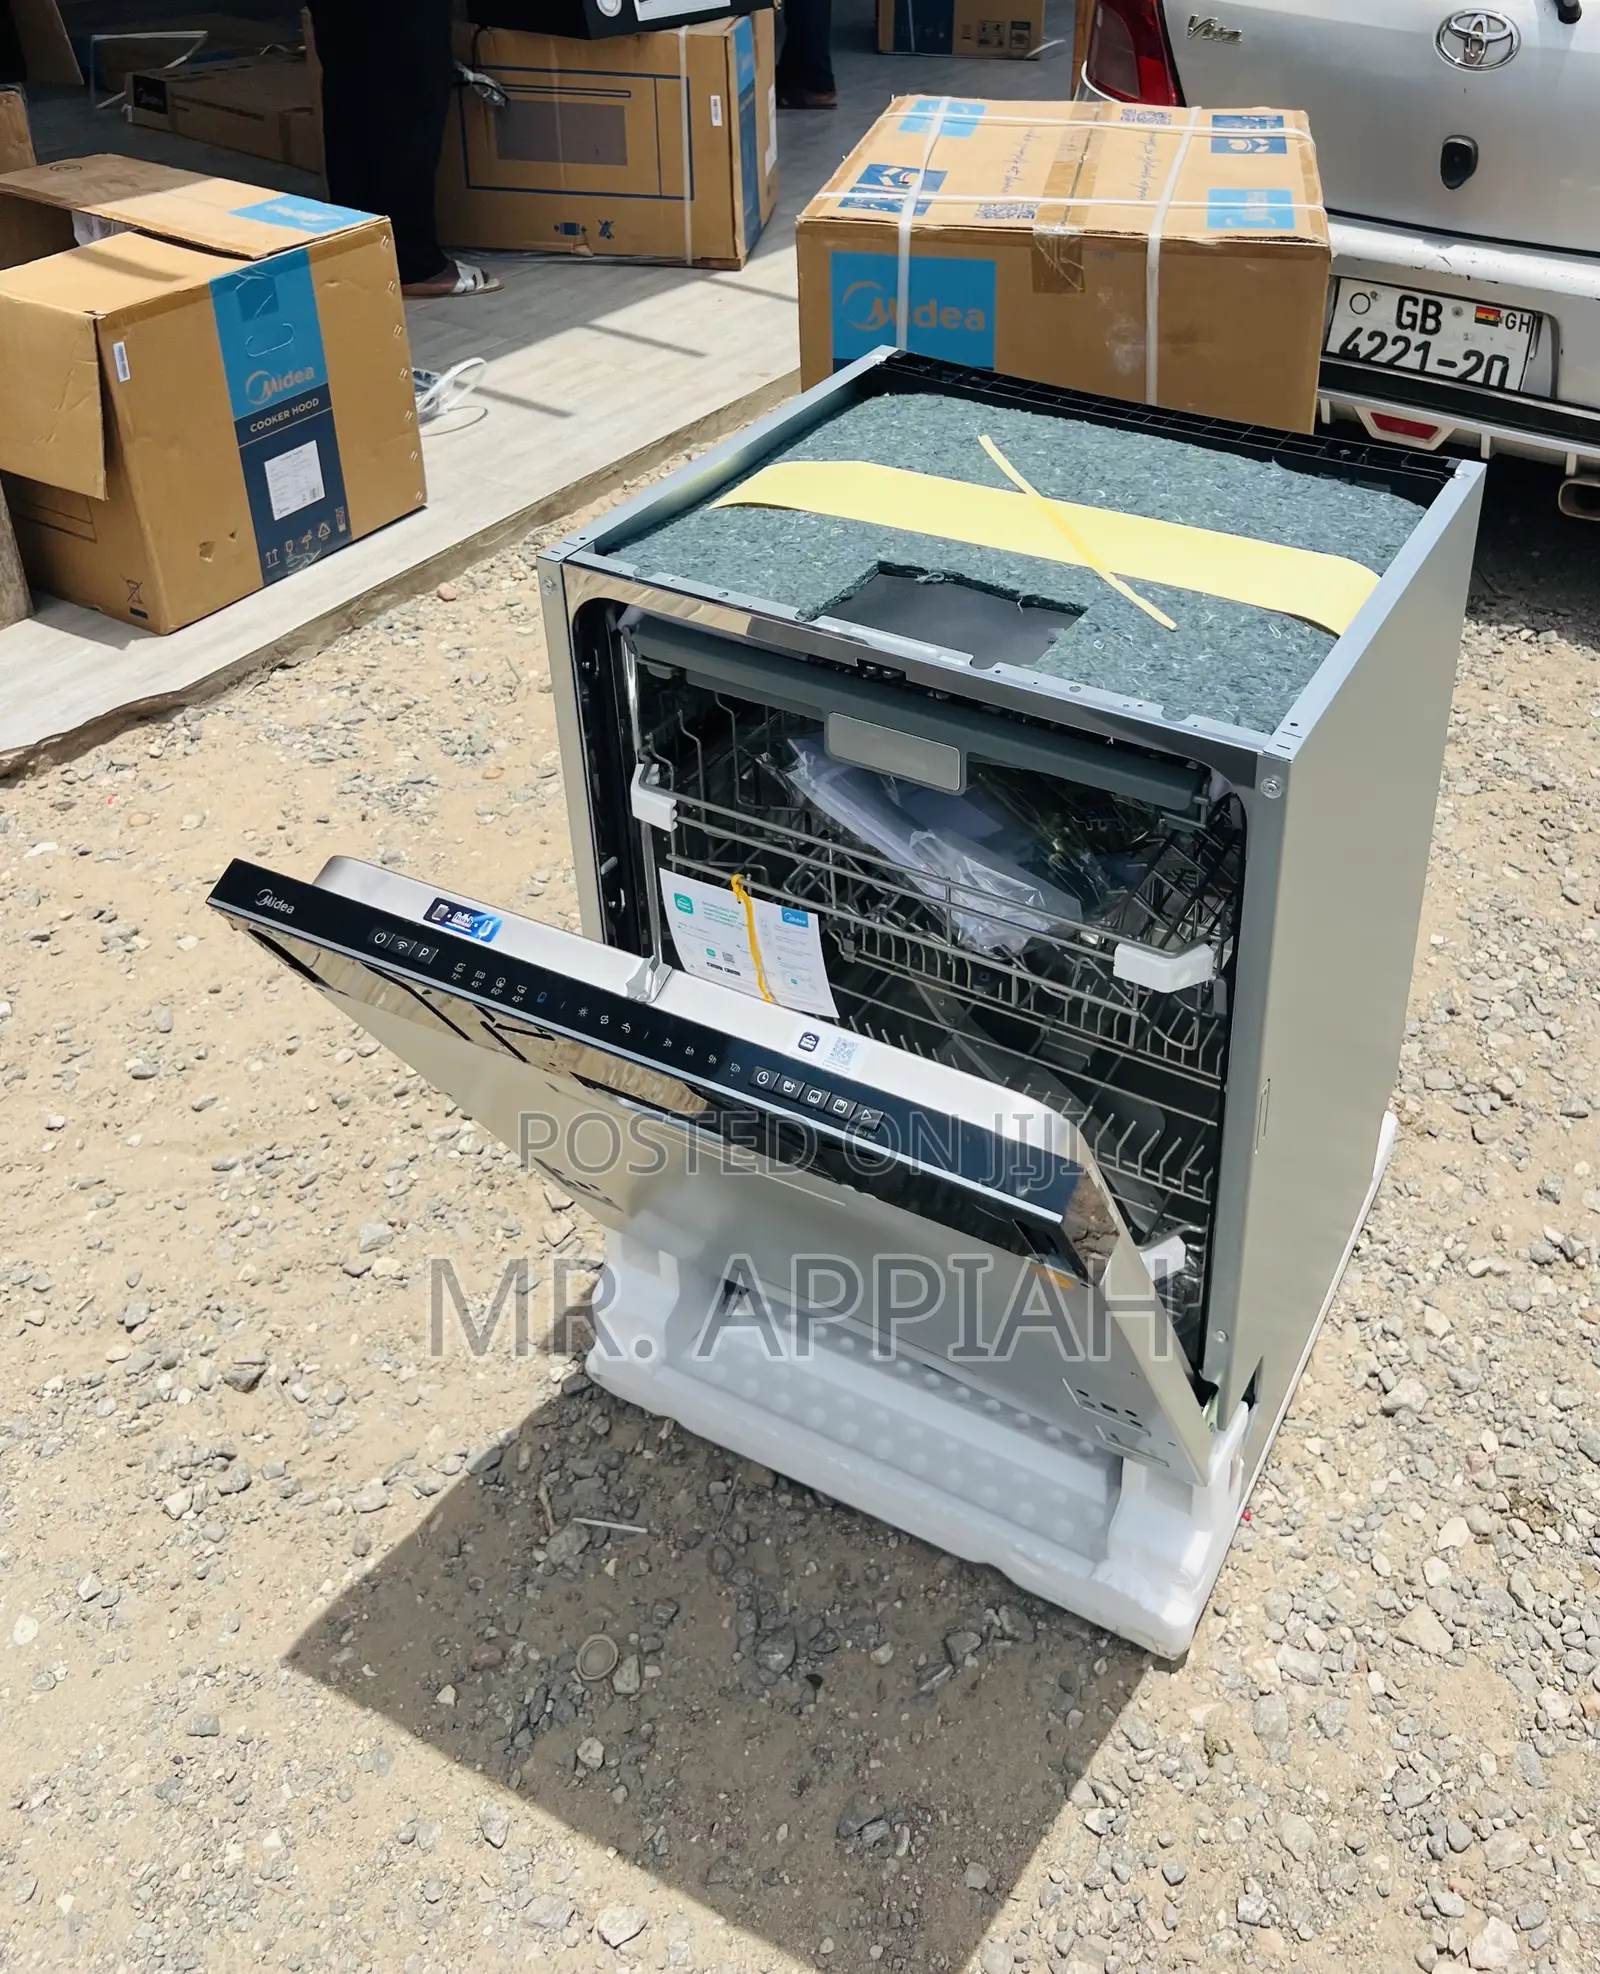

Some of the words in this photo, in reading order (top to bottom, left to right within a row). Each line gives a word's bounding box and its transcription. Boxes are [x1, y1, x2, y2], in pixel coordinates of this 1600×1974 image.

[842, 280, 985, 332] Mdea
[1396, 294, 1443, 336] GB
[1505, 312, 1532, 334] GH
[1338, 326, 1510, 390] 4221-20
[246, 367, 315, 405] Midea
[250, 410, 290, 432] COOKER
[292, 398, 319, 415] HOOD
[255, 888, 295, 914] Midea
[418, 947, 430, 958] P
[663, 1037, 673, 1048] 3h
[685, 1046, 695, 1056] 6h
[708, 1054, 717, 1064] 9h
[730, 1062, 741, 1073] 12h
